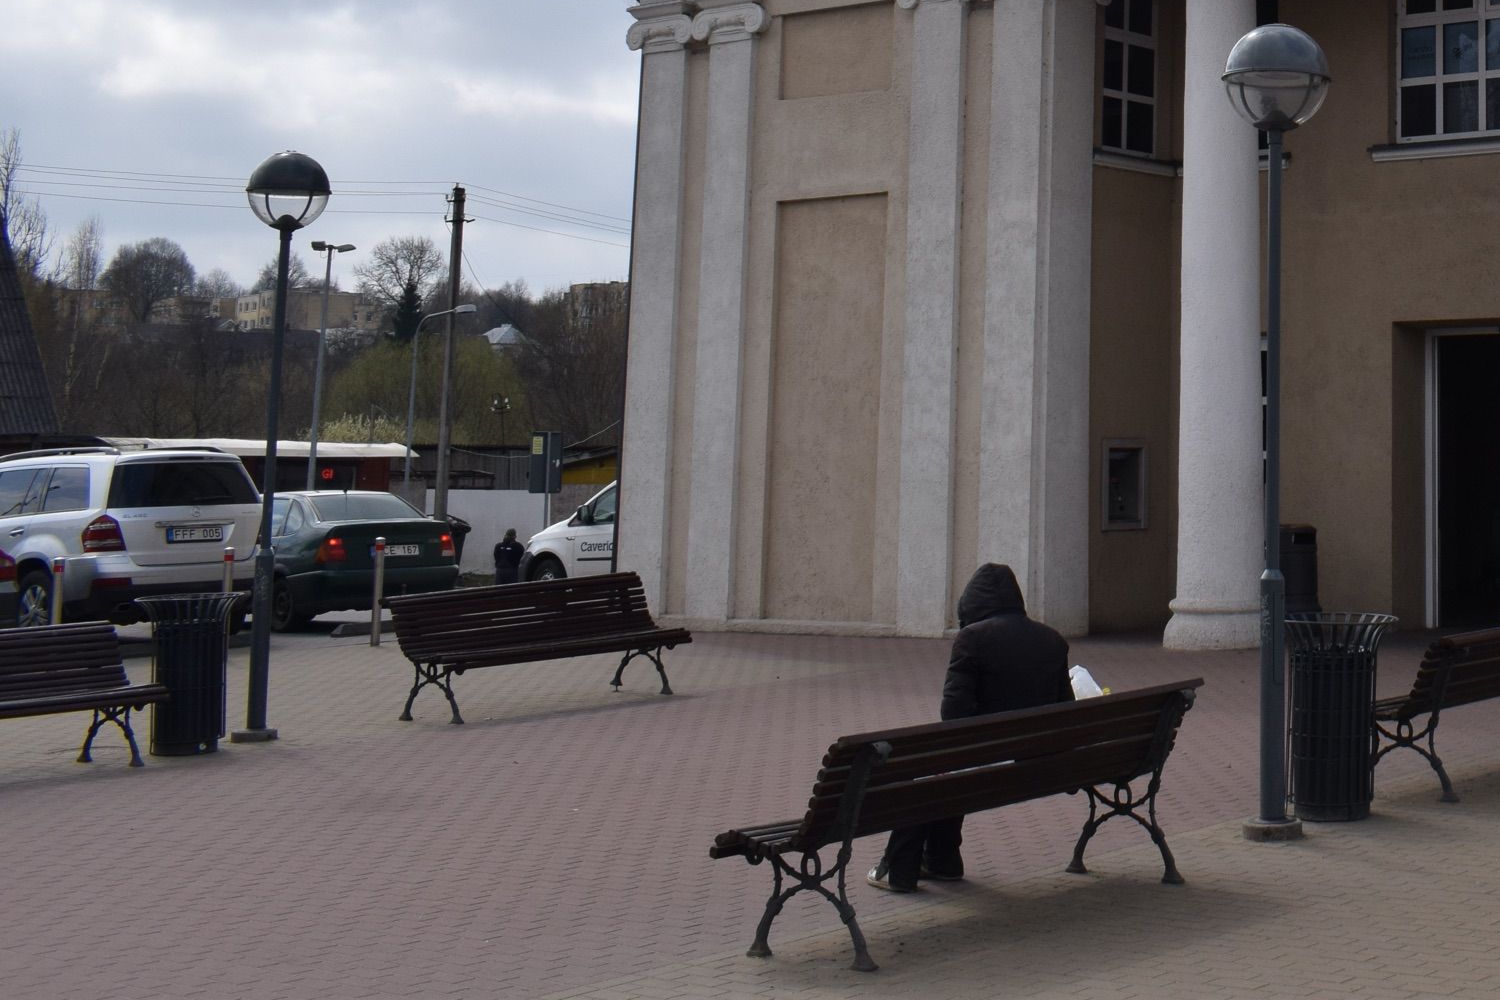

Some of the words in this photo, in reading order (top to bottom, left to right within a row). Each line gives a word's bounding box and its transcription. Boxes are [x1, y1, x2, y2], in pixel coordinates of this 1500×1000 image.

[174, 529, 196, 540] FFF
[202, 528, 221, 539] 005
[402, 545, 418, 555] 167
